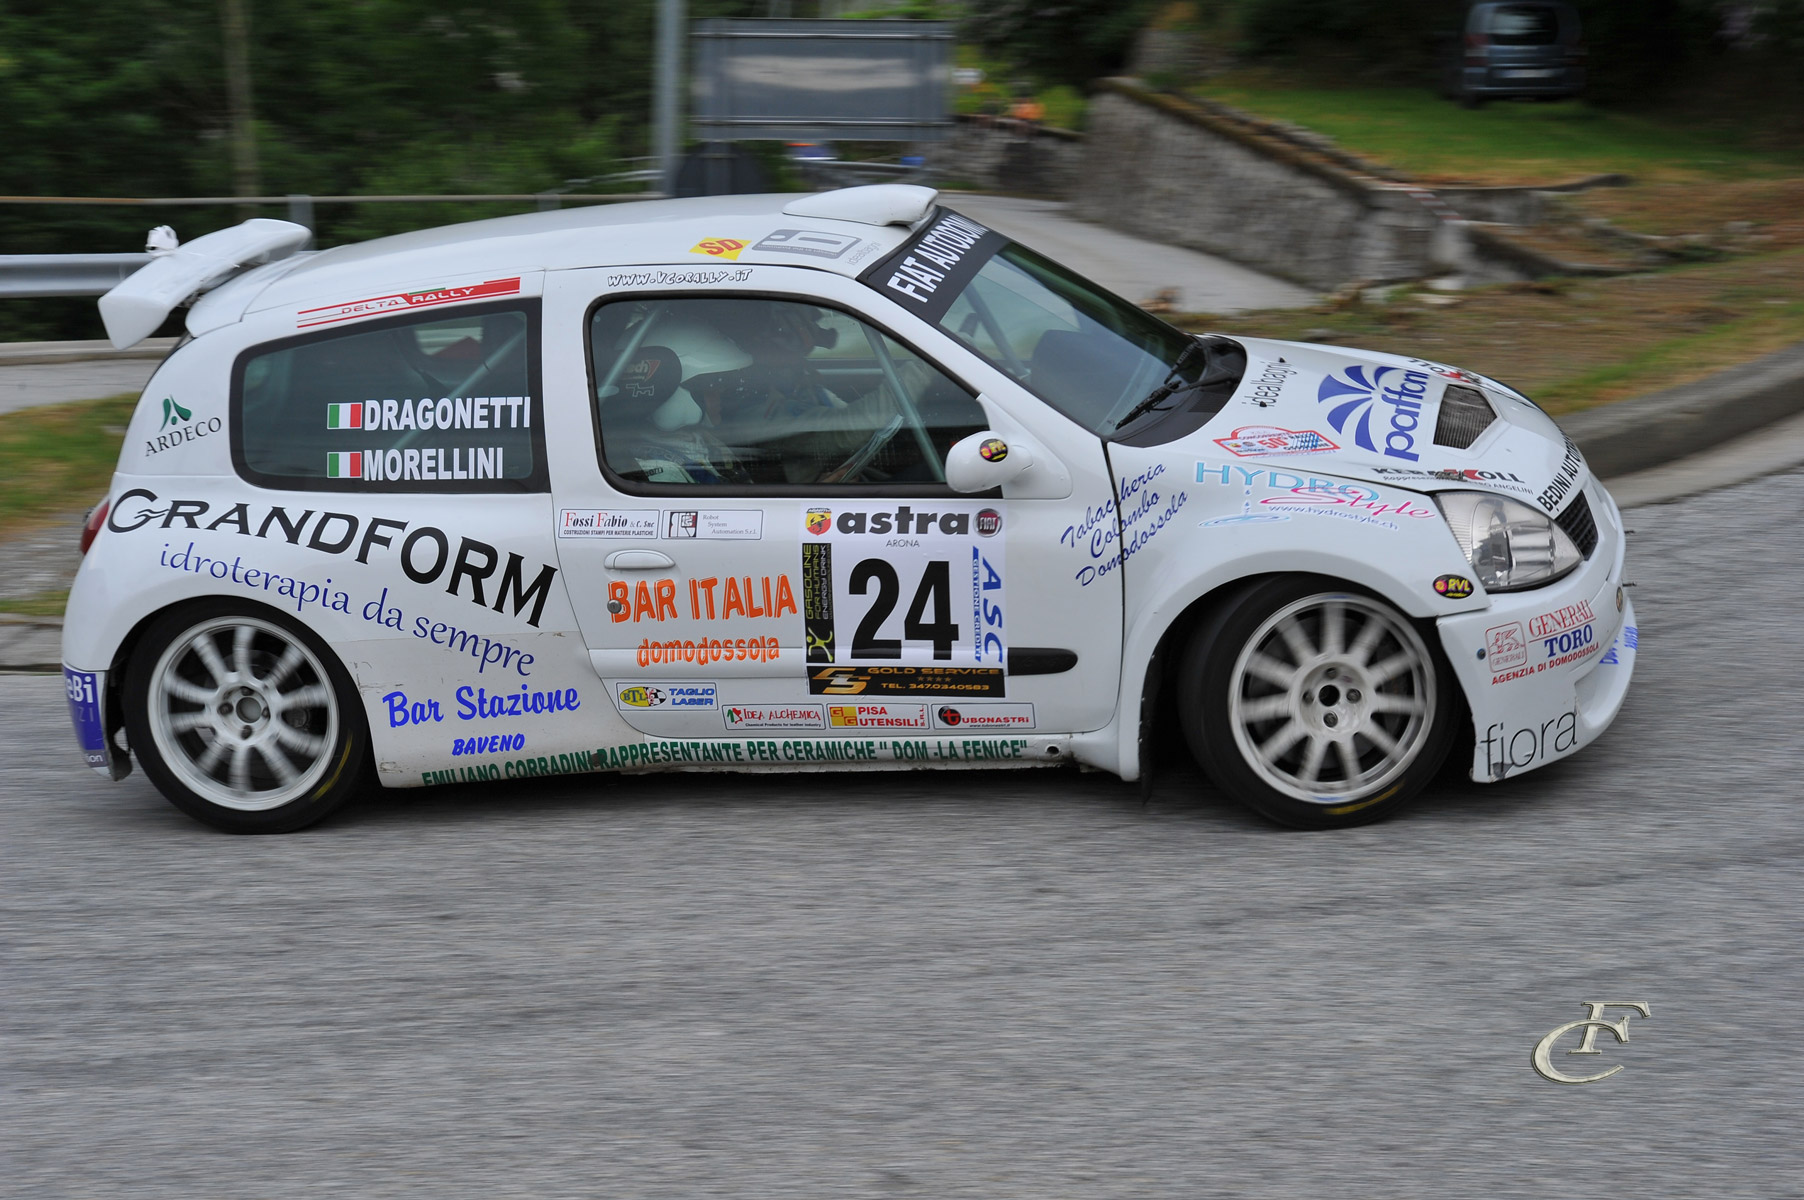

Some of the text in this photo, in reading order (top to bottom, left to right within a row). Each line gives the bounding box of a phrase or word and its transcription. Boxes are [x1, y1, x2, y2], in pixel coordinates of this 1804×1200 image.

[699, 239, 744, 256] SD
[887, 256, 945, 303] FIAT
[341, 287, 474, 314] DELTA RALLY
[364, 396, 531, 431] DRAGONETTI
[143, 417, 222, 458] ARDECO
[364, 447, 503, 481] MORELLINI
[1195, 462, 1380, 501] HYDRO
[1260, 487, 1436, 519] Style
[1493, 483, 1534, 496] ANGELINI
[1536, 472, 1572, 512] BEDINI
[565, 512, 594, 527] Fossi
[597, 512, 628, 528] Fabio
[836, 506, 970, 535] astra
[979, 516, 997, 530] FIAT
[1090, 489, 1160, 559] Colombo
[1268, 505, 1399, 531] www.hydrostyle.ch
[885, 539, 920, 547] ARONA
[1075, 491, 1188, 587] Domodossola
[107, 488, 559, 629] GRANDFORM
[607, 579, 678, 623] BAR
[689, 574, 797, 621] ITALIA
[803, 544, 814, 620] GASOLINE
[812, 545, 822, 620] FOR HUMANS
[821, 578, 829, 620] ENERGY
[1448, 578, 1471, 591] RVL
[160, 542, 535, 676] idroterapia da sempre
[849, 558, 959, 660] 24
[982, 556, 1004, 663] ASC
[1529, 599, 1595, 638] GENERALI
[637, 635, 780, 668] domodossola
[1544, 624, 1593, 658] TORO
[1491, 666, 1535, 685] AGENZIA
[1537, 660, 1547, 673] DI
[1549, 642, 1599, 669] DOMODOSSOLA
[382, 684, 581, 728] Bar Stazione
[623, 690, 647, 703] BTL
[669, 688, 715, 696] TAGLIO
[743, 708, 822, 721] IDEA ALCHEMICA
[858, 706, 888, 715] PISA
[859, 718, 919, 727] UTENSILI
[452, 733, 526, 756] BAVENO
[1480, 711, 1578, 776] fiora
[421, 763, 500, 787] EMILIANO
[504, 750, 597, 780] CORRADINI
[597, 741, 744, 770] RAPPRESENTANTE
[747, 741, 778, 761] PER
[782, 740, 877, 761] CERAMICHE
[892, 741, 930, 761] DOM
